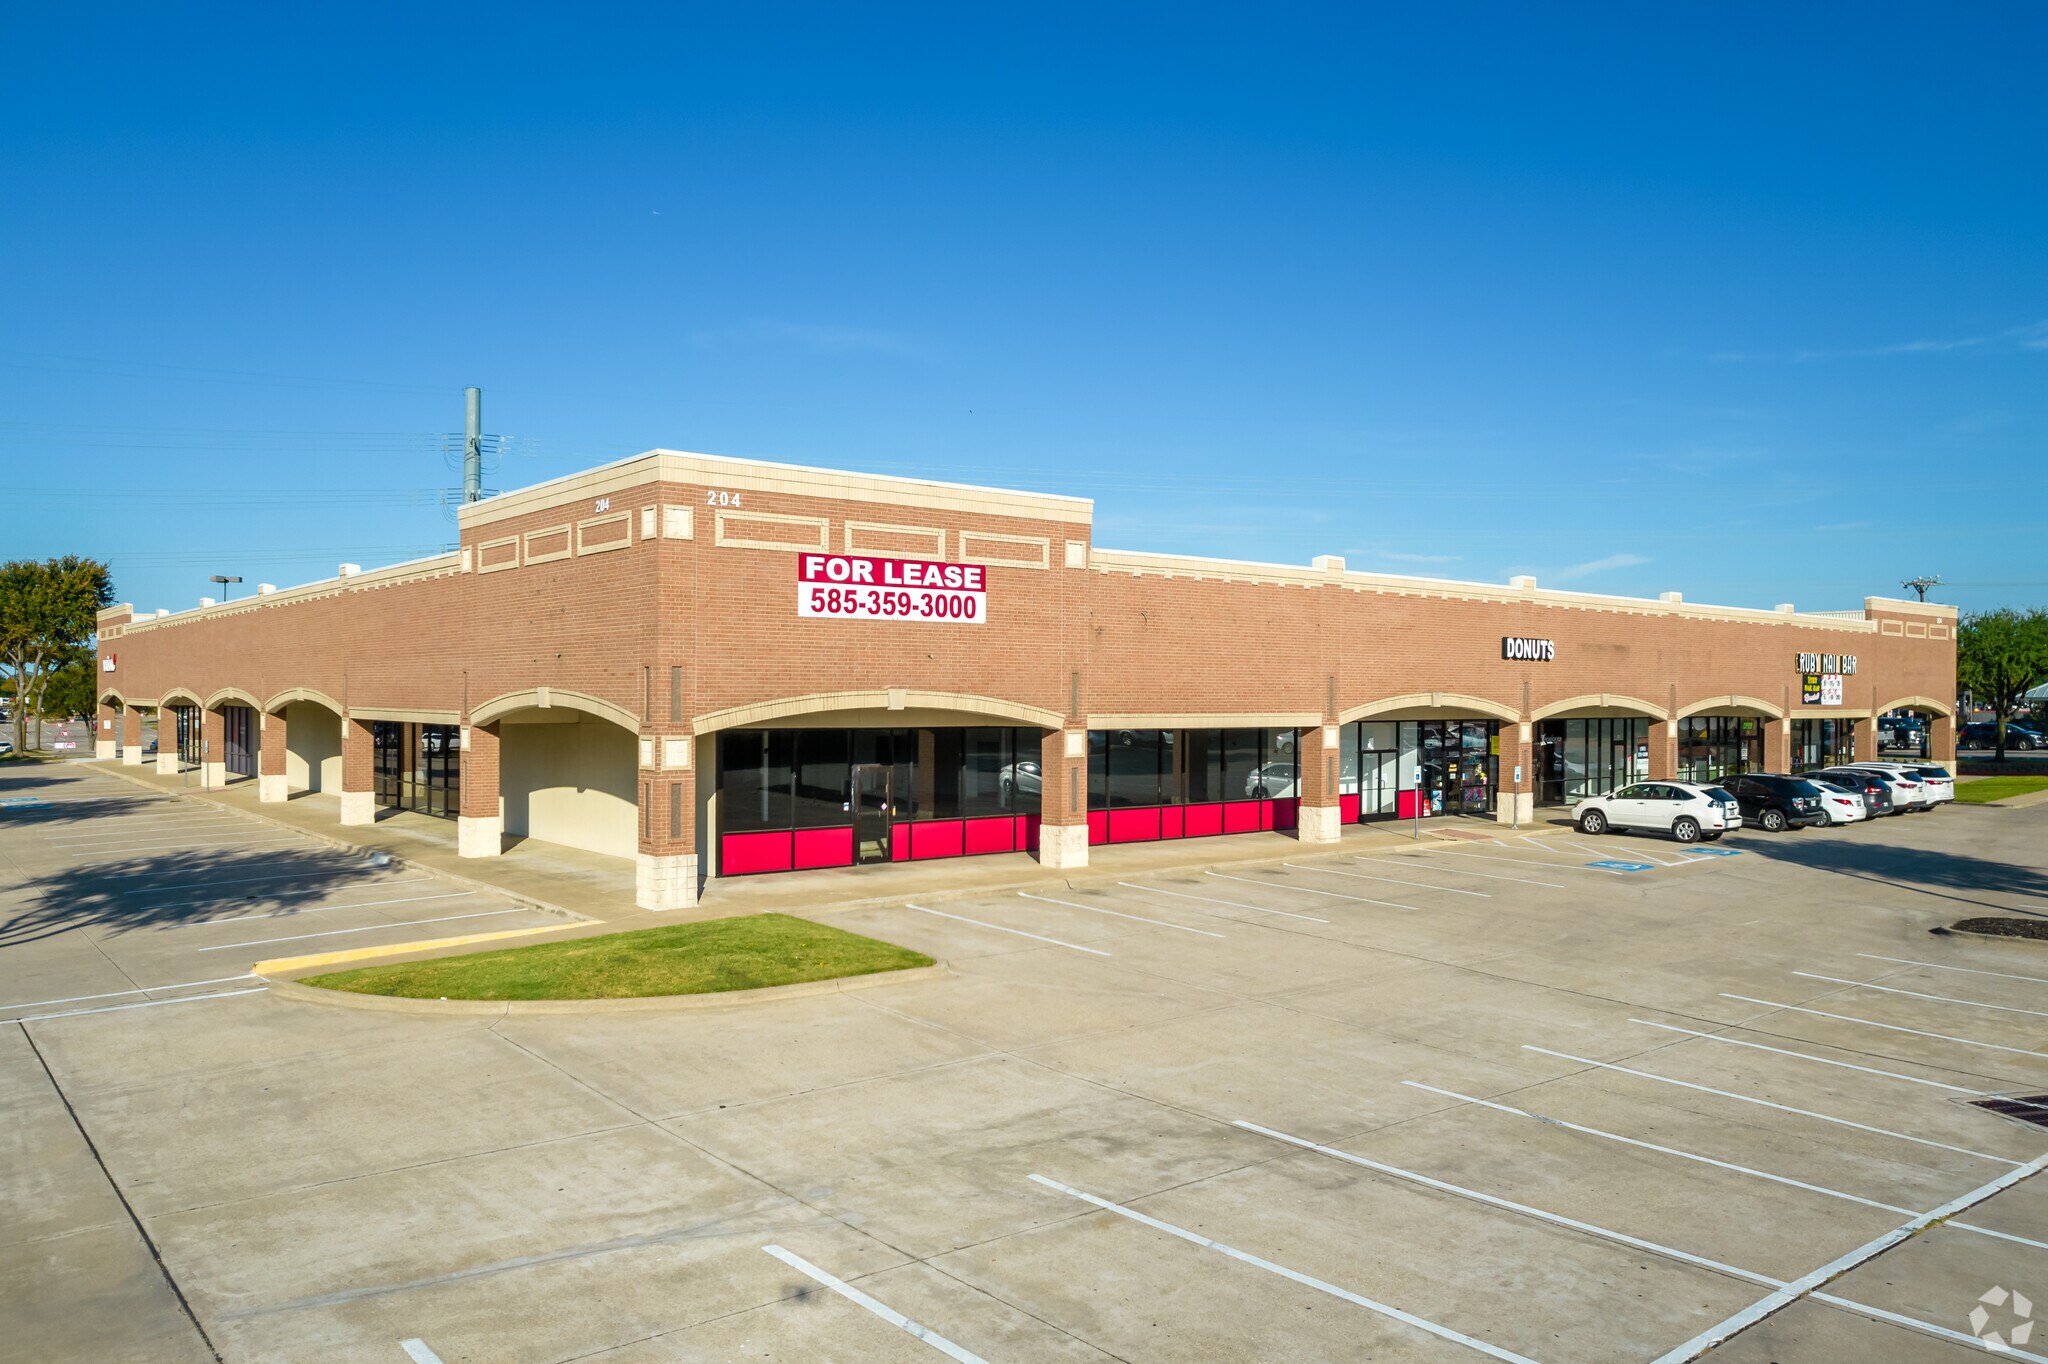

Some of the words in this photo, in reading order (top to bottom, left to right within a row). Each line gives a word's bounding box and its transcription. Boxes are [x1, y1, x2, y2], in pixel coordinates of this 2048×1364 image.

[595, 498, 610, 513] 204
[707, 490, 741, 508] 204
[805, 556, 875, 584] FOR
[884, 561, 982, 590] LEASE
[810, 587, 977, 619] 585-359-3000
[1506, 637, 1555, 660] DONUTS
[1799, 652, 1820, 673] RUBY
[1822, 654, 1839, 674] NAIL
[1842, 655, 1857, 674] BAR
